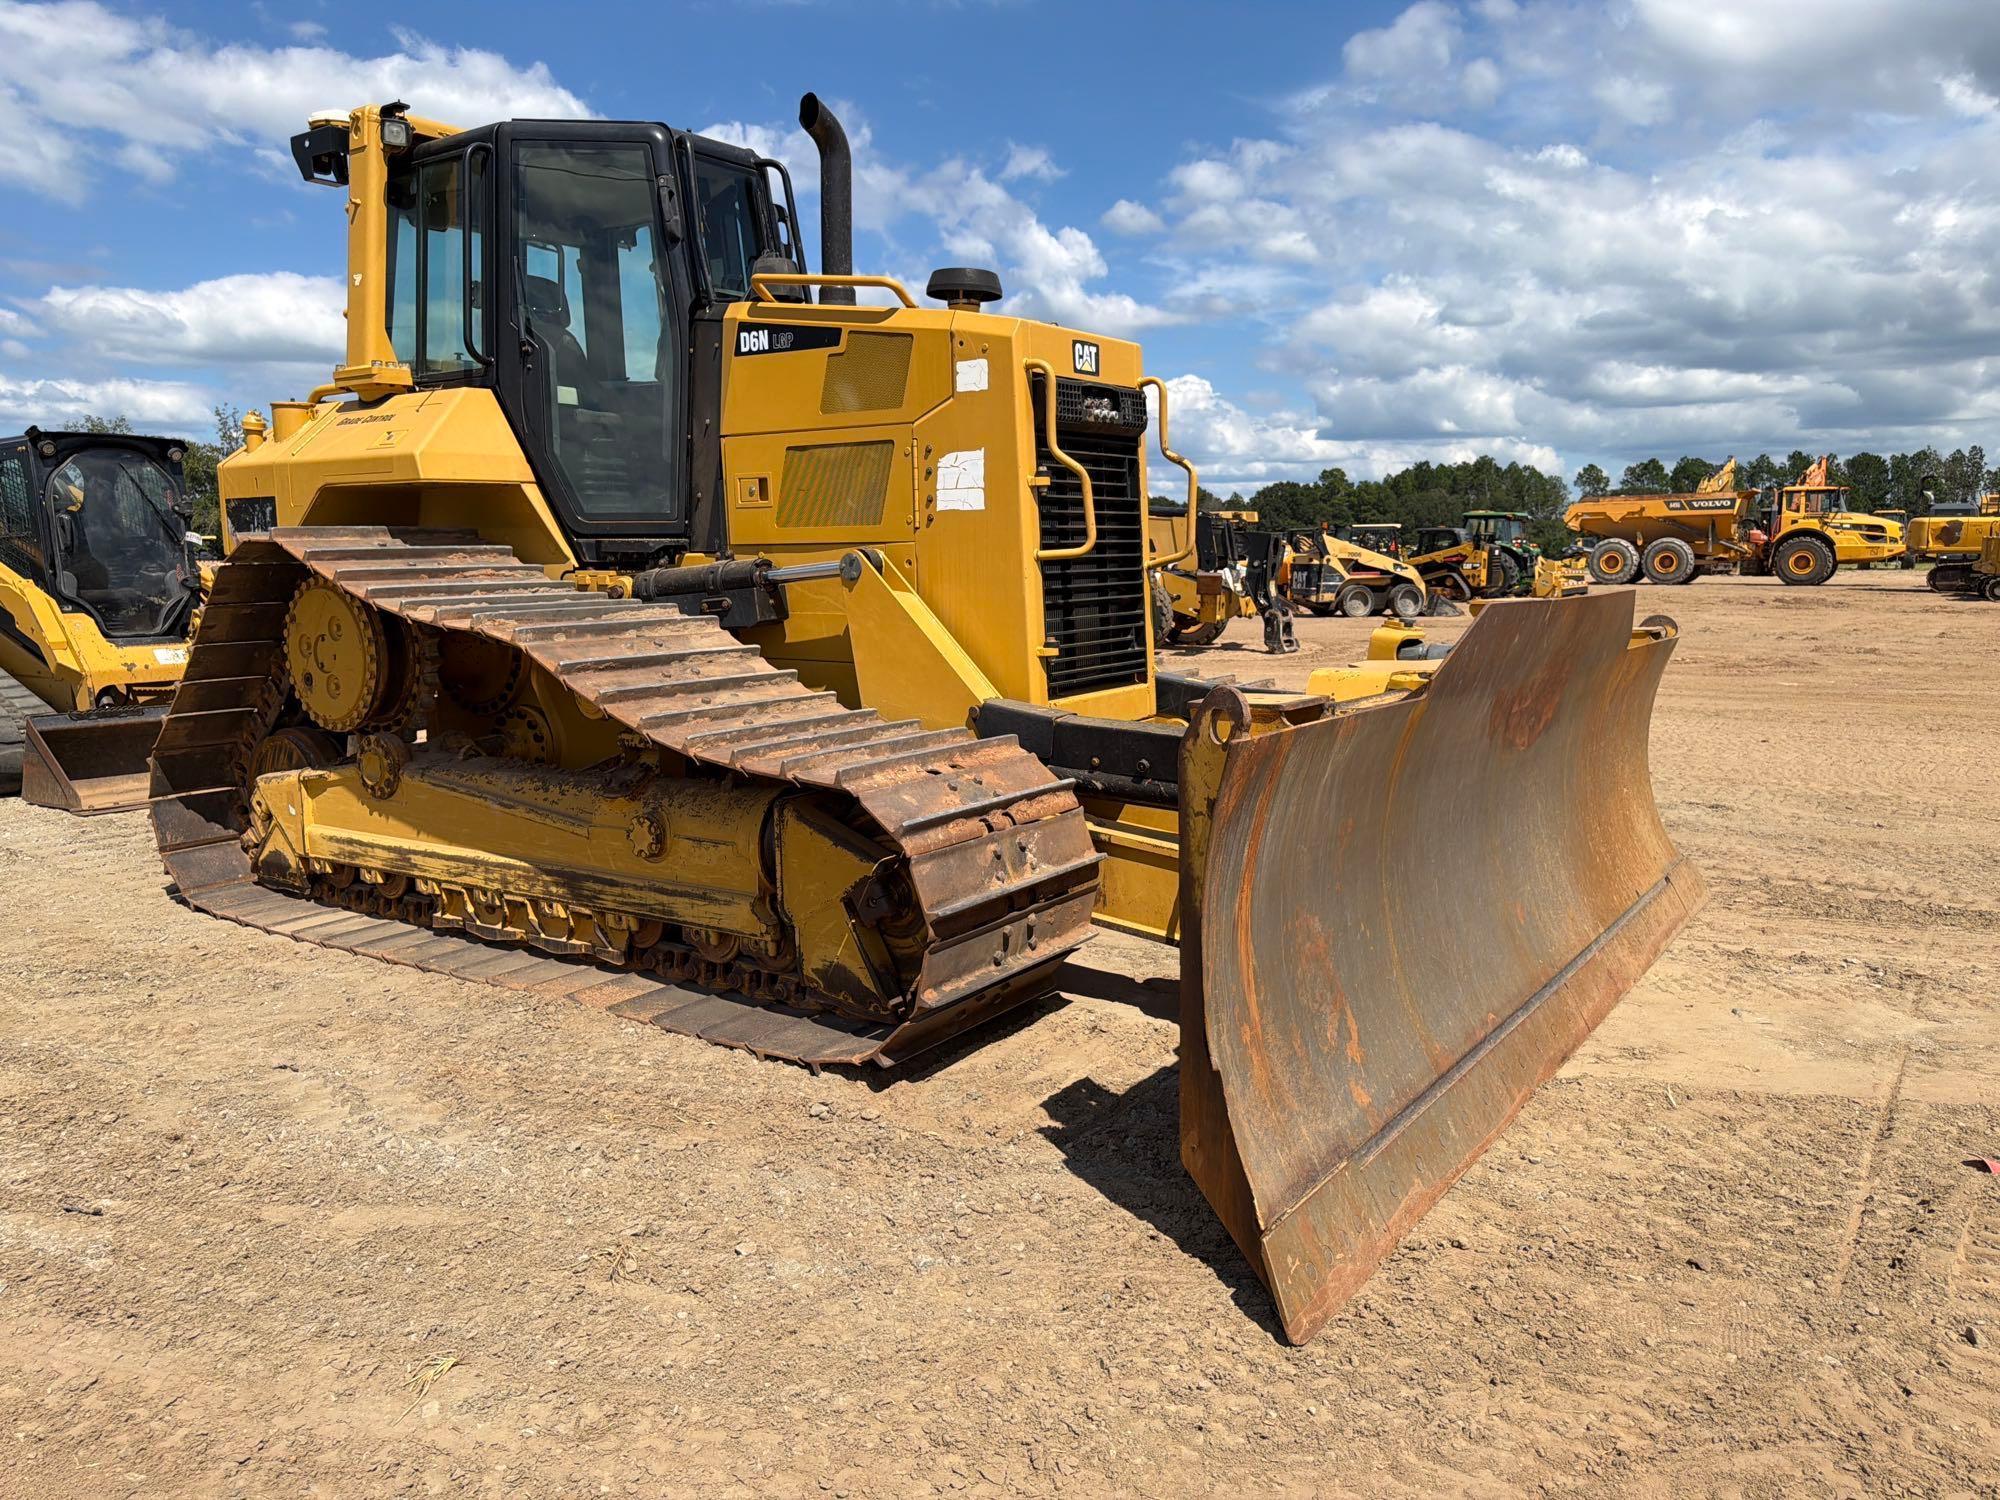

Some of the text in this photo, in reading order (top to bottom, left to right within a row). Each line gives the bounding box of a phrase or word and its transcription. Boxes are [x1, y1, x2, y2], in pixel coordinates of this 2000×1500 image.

[740, 330, 794, 352] D6N LGP
[1075, 343, 1097, 373] CAT
[1692, 500, 1731, 508] VOLVO
